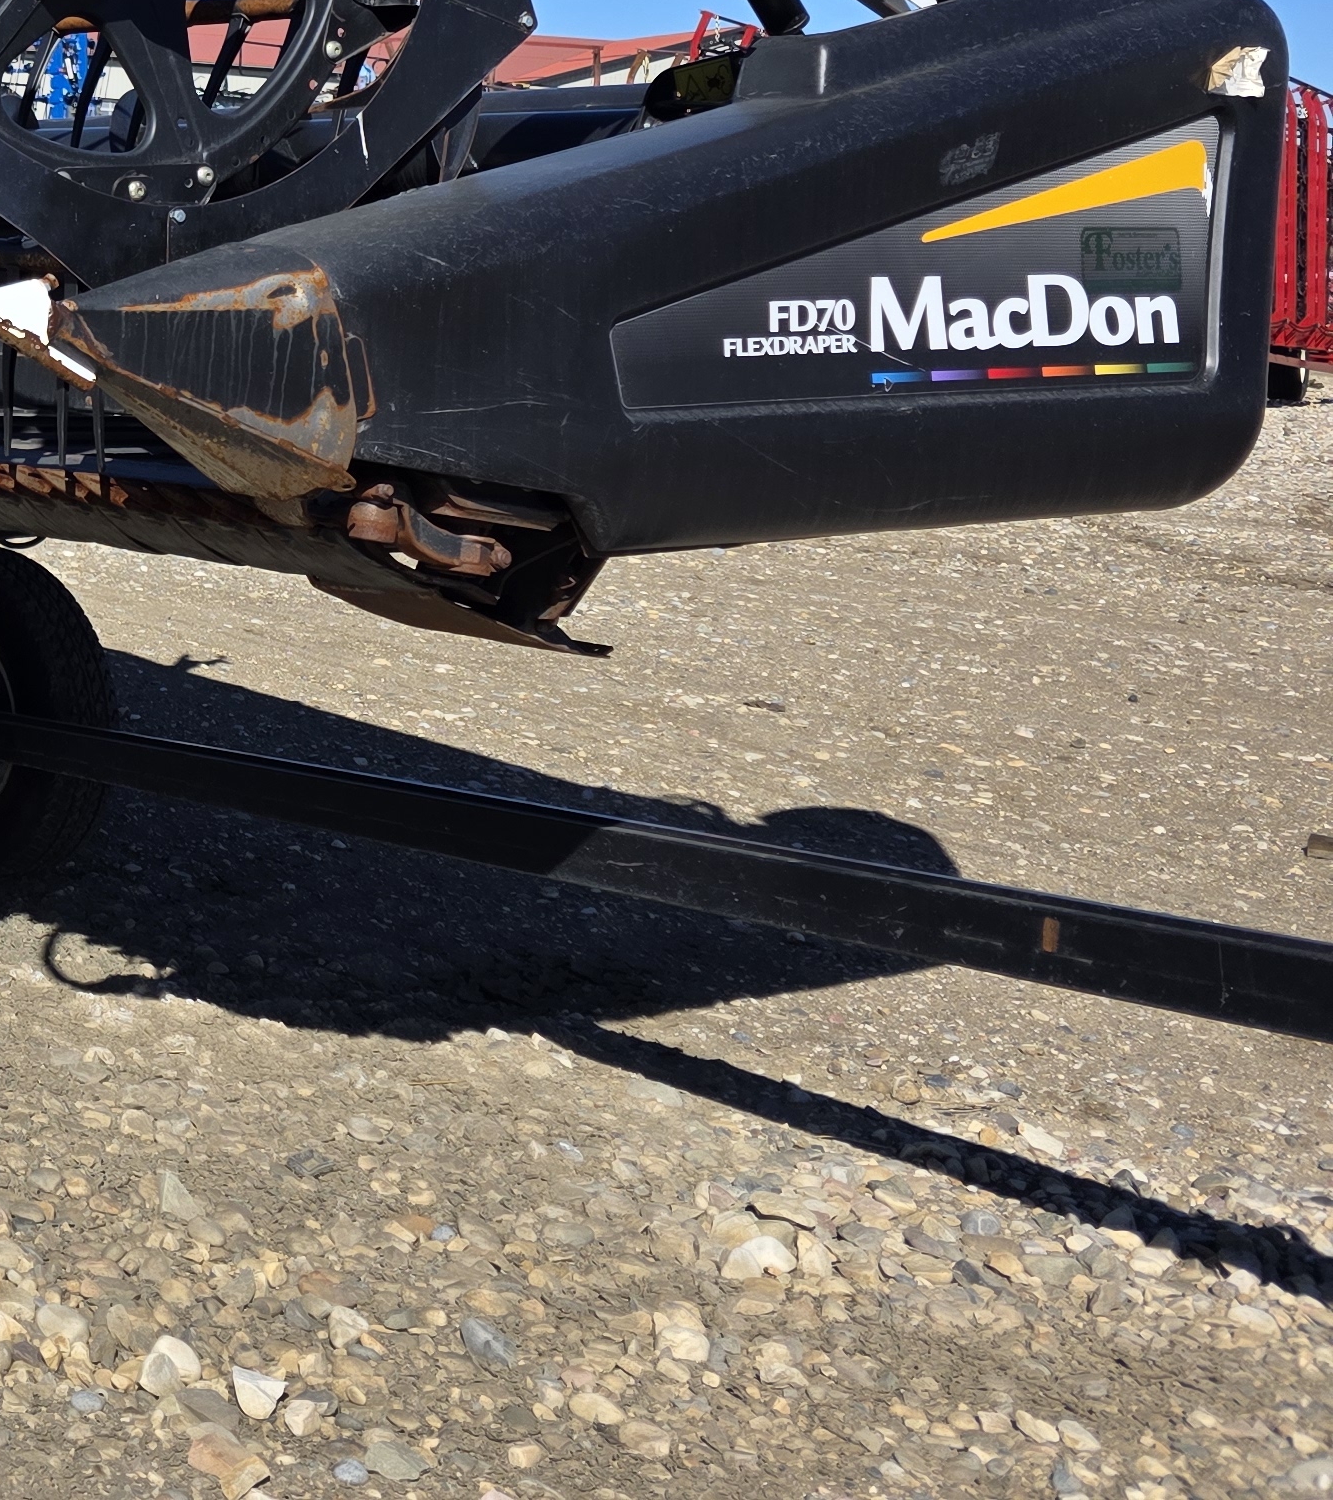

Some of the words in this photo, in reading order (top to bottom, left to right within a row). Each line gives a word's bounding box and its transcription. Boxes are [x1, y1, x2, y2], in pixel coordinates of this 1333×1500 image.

[1081, 231, 1181, 271] Foster's
[769, 299, 856, 332] FD70
[870, 274, 1180, 353] MacDon
[723, 334, 858, 358] FLEXDRAPER
